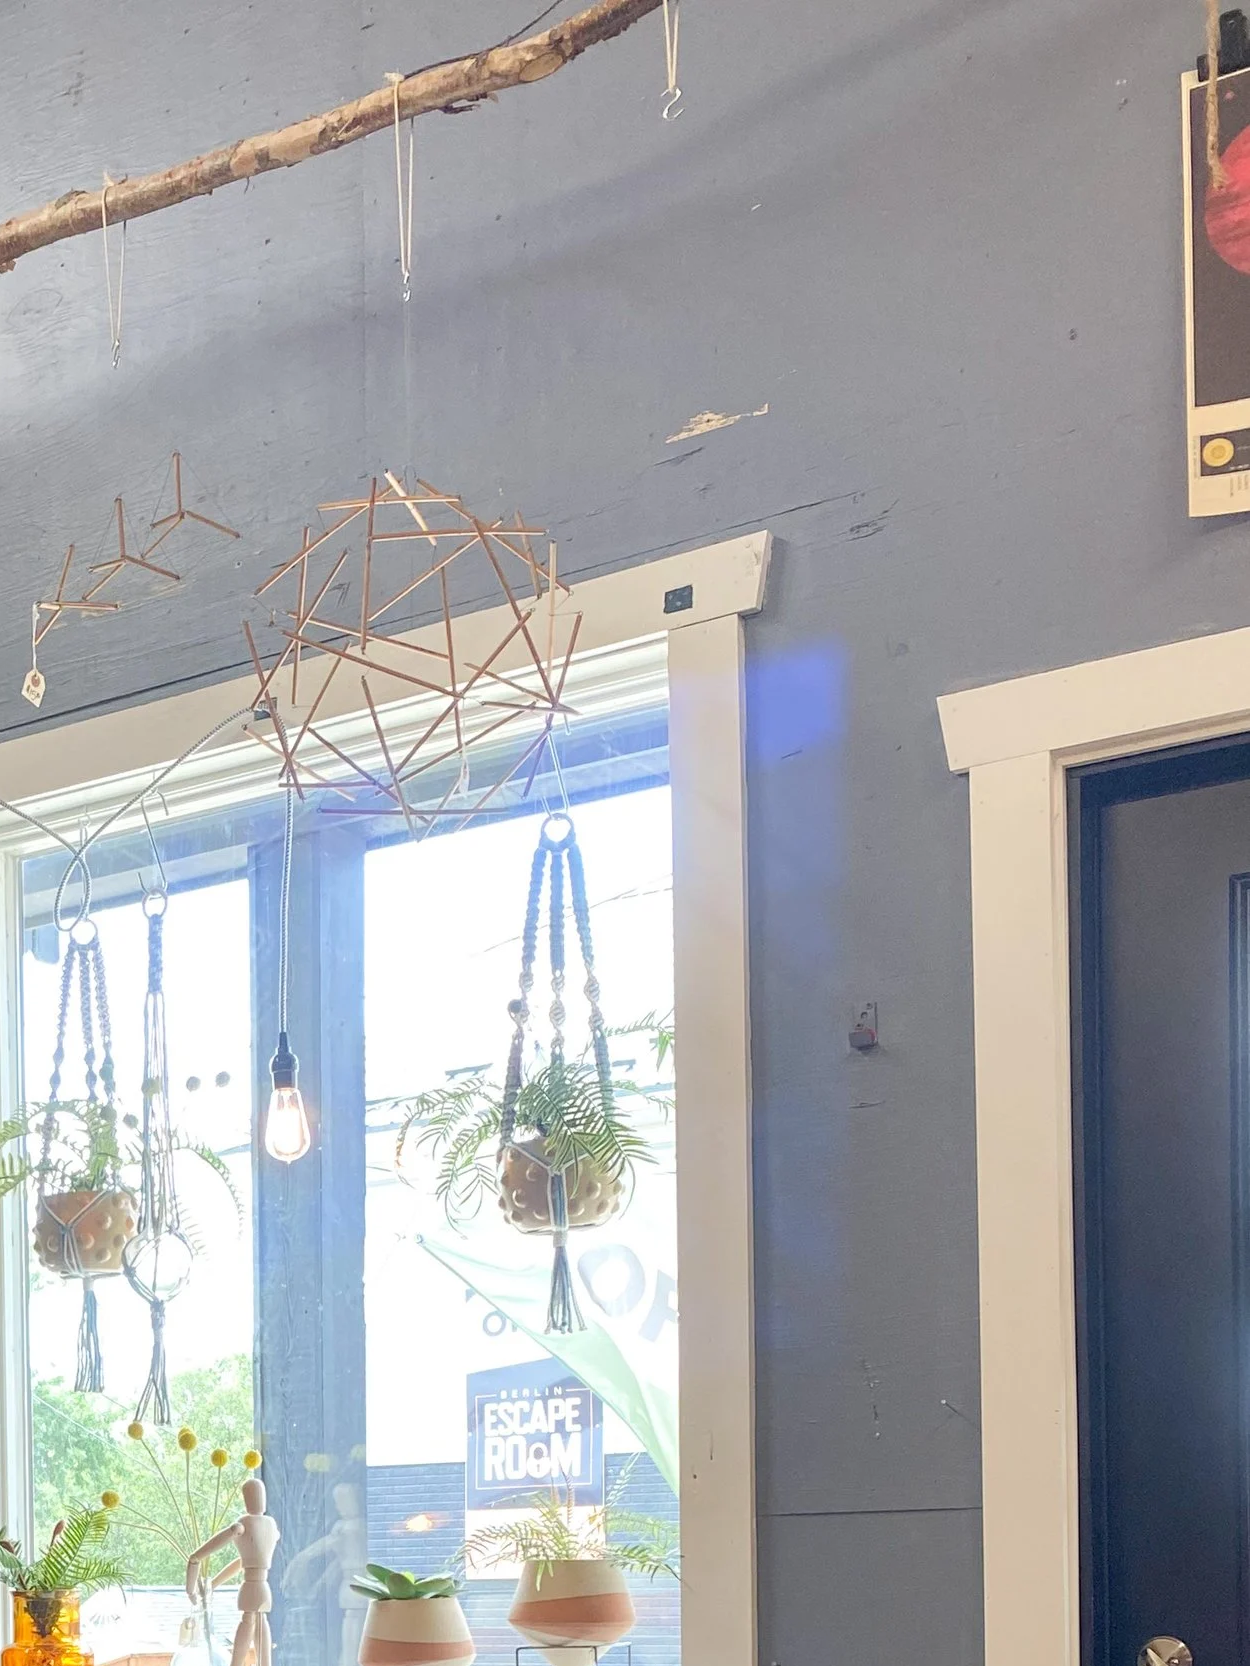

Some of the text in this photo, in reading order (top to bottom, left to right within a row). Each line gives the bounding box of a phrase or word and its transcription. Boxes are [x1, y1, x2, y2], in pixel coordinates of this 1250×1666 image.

[499, 1385, 563, 1400] BERLIN
[484, 1397, 582, 1437] ESCAPE
[484, 1432, 582, 1481] ROOM
